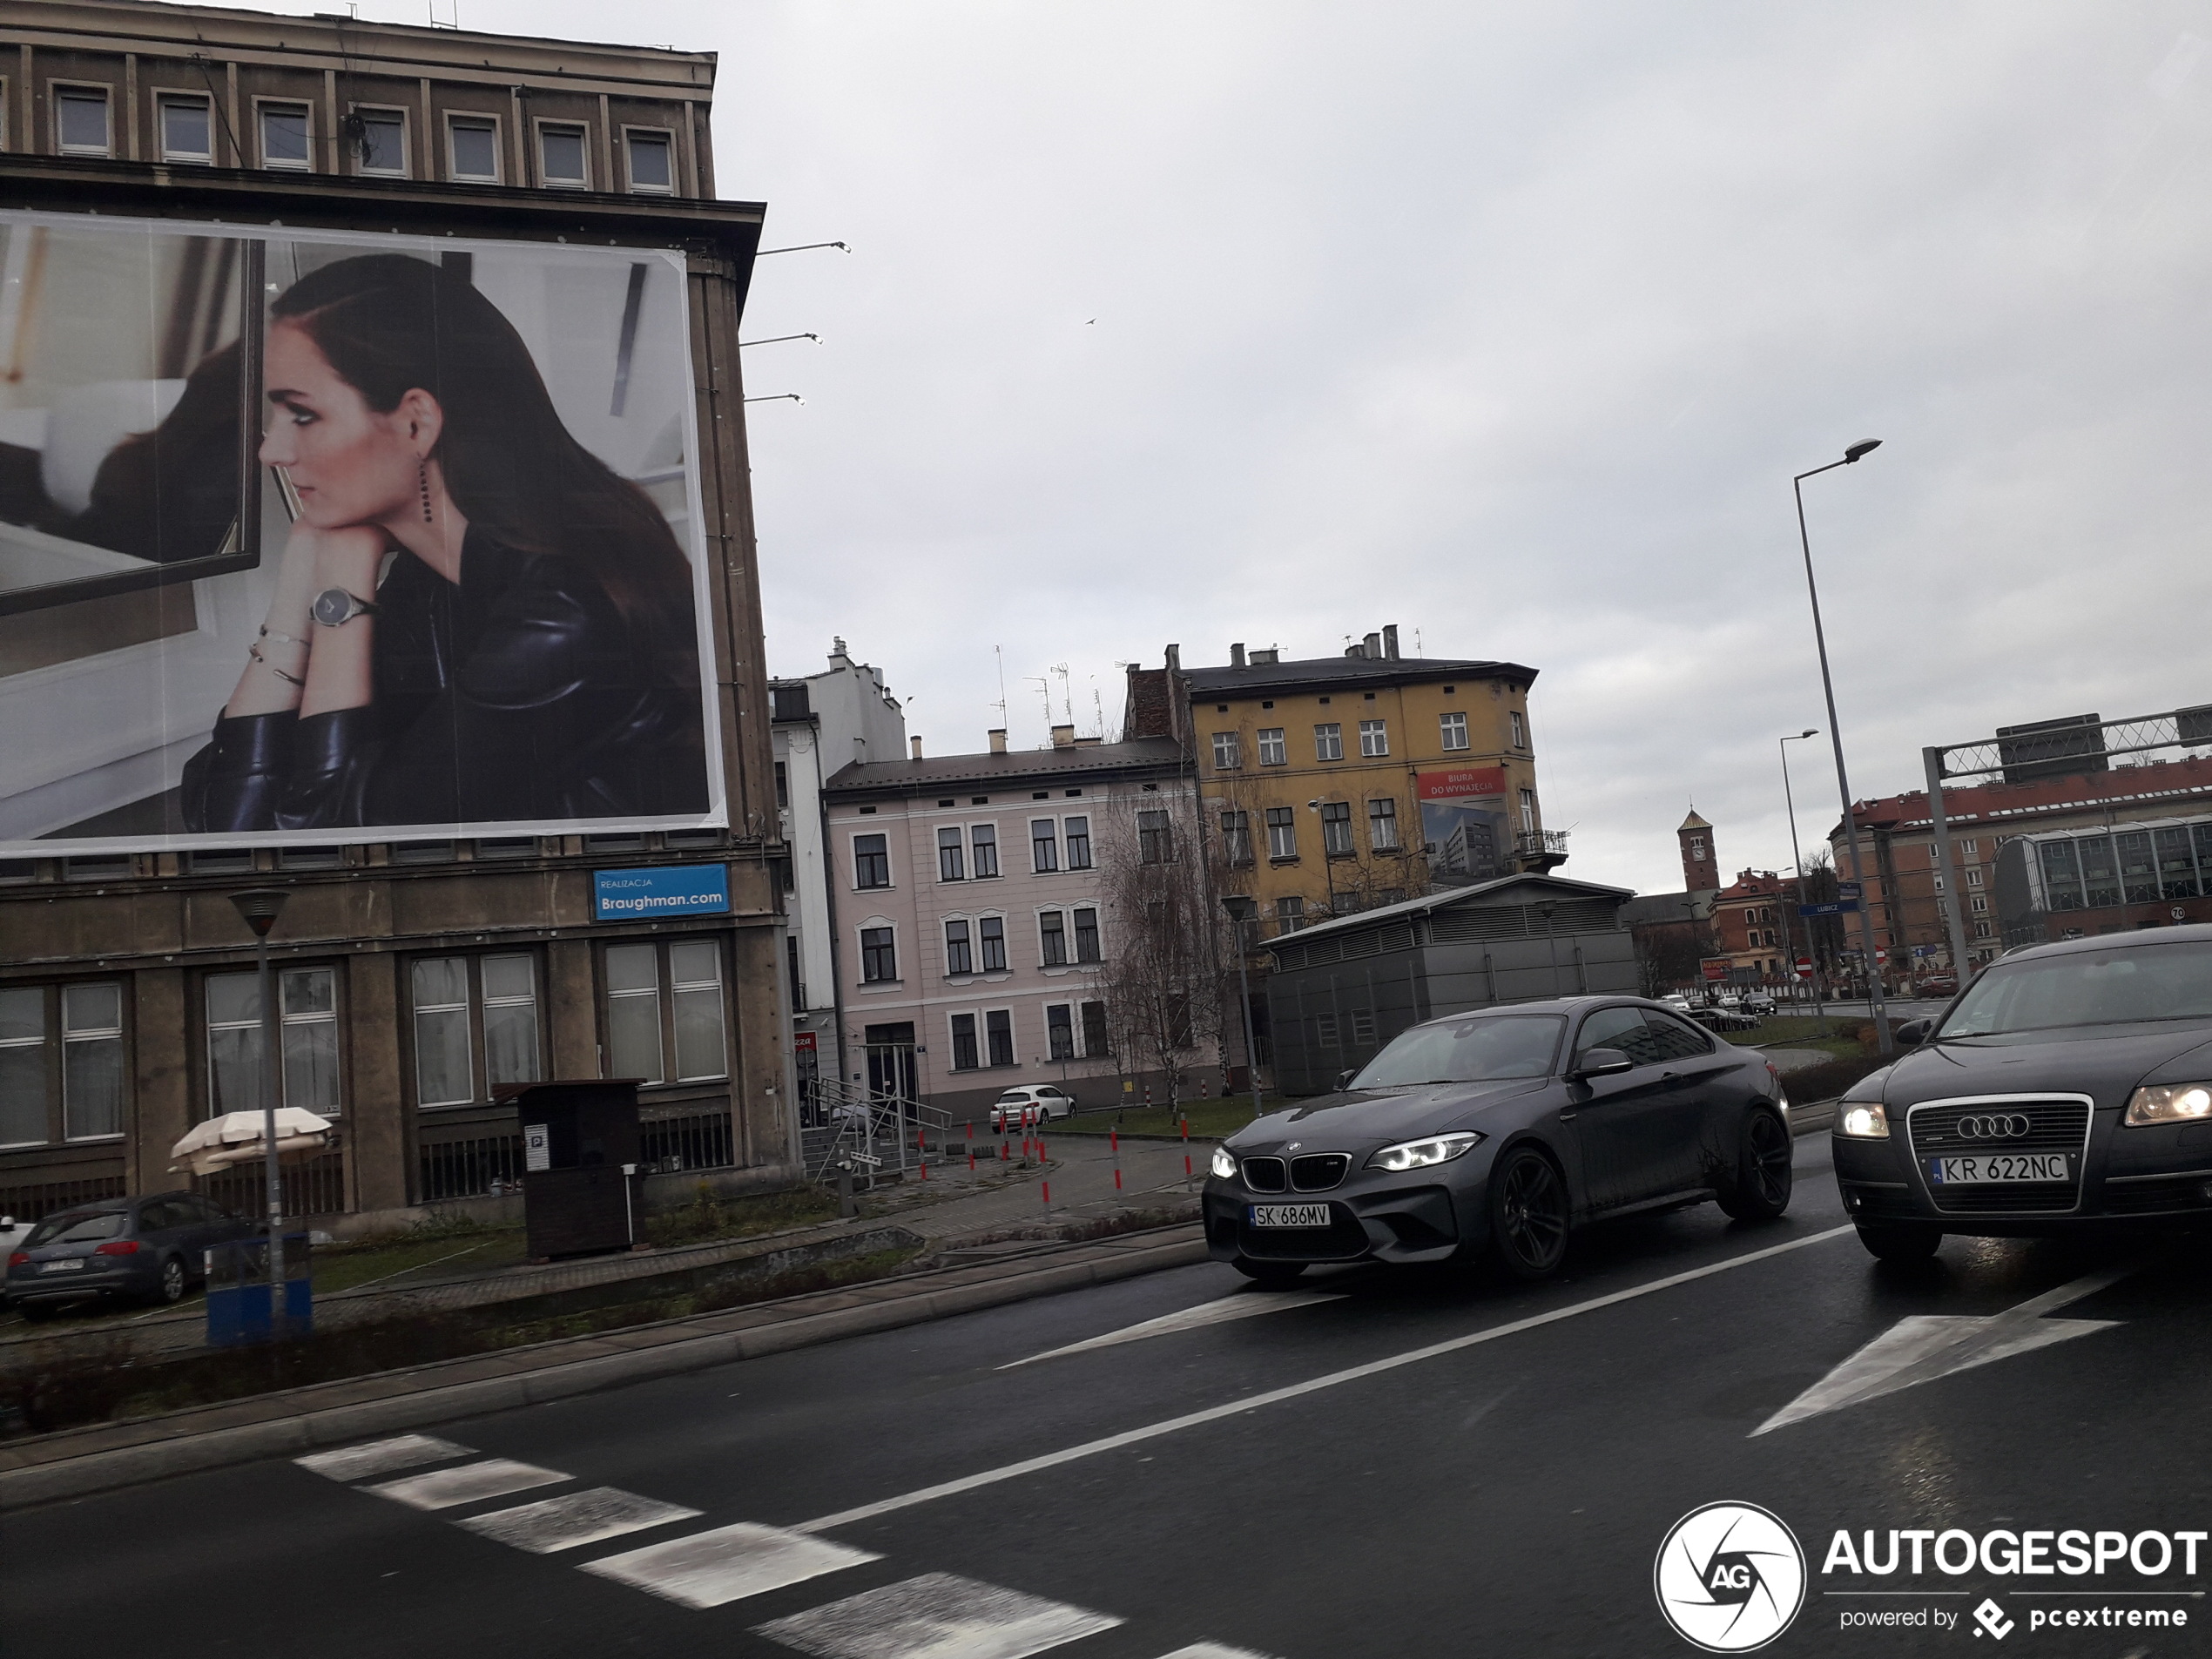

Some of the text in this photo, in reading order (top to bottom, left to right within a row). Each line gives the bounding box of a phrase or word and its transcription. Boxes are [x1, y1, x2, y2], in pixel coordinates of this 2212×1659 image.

[1449, 773, 1474, 782] BIURA
[1446, 783, 1493, 792] WYNAJĘCIA
[601, 880, 652, 888] REALIZACJA
[603, 893, 722, 910] Braughman.com
[1945, 1157, 2063, 1180] KR 622NC
[1257, 1206, 1325, 1224] SK 686MV
